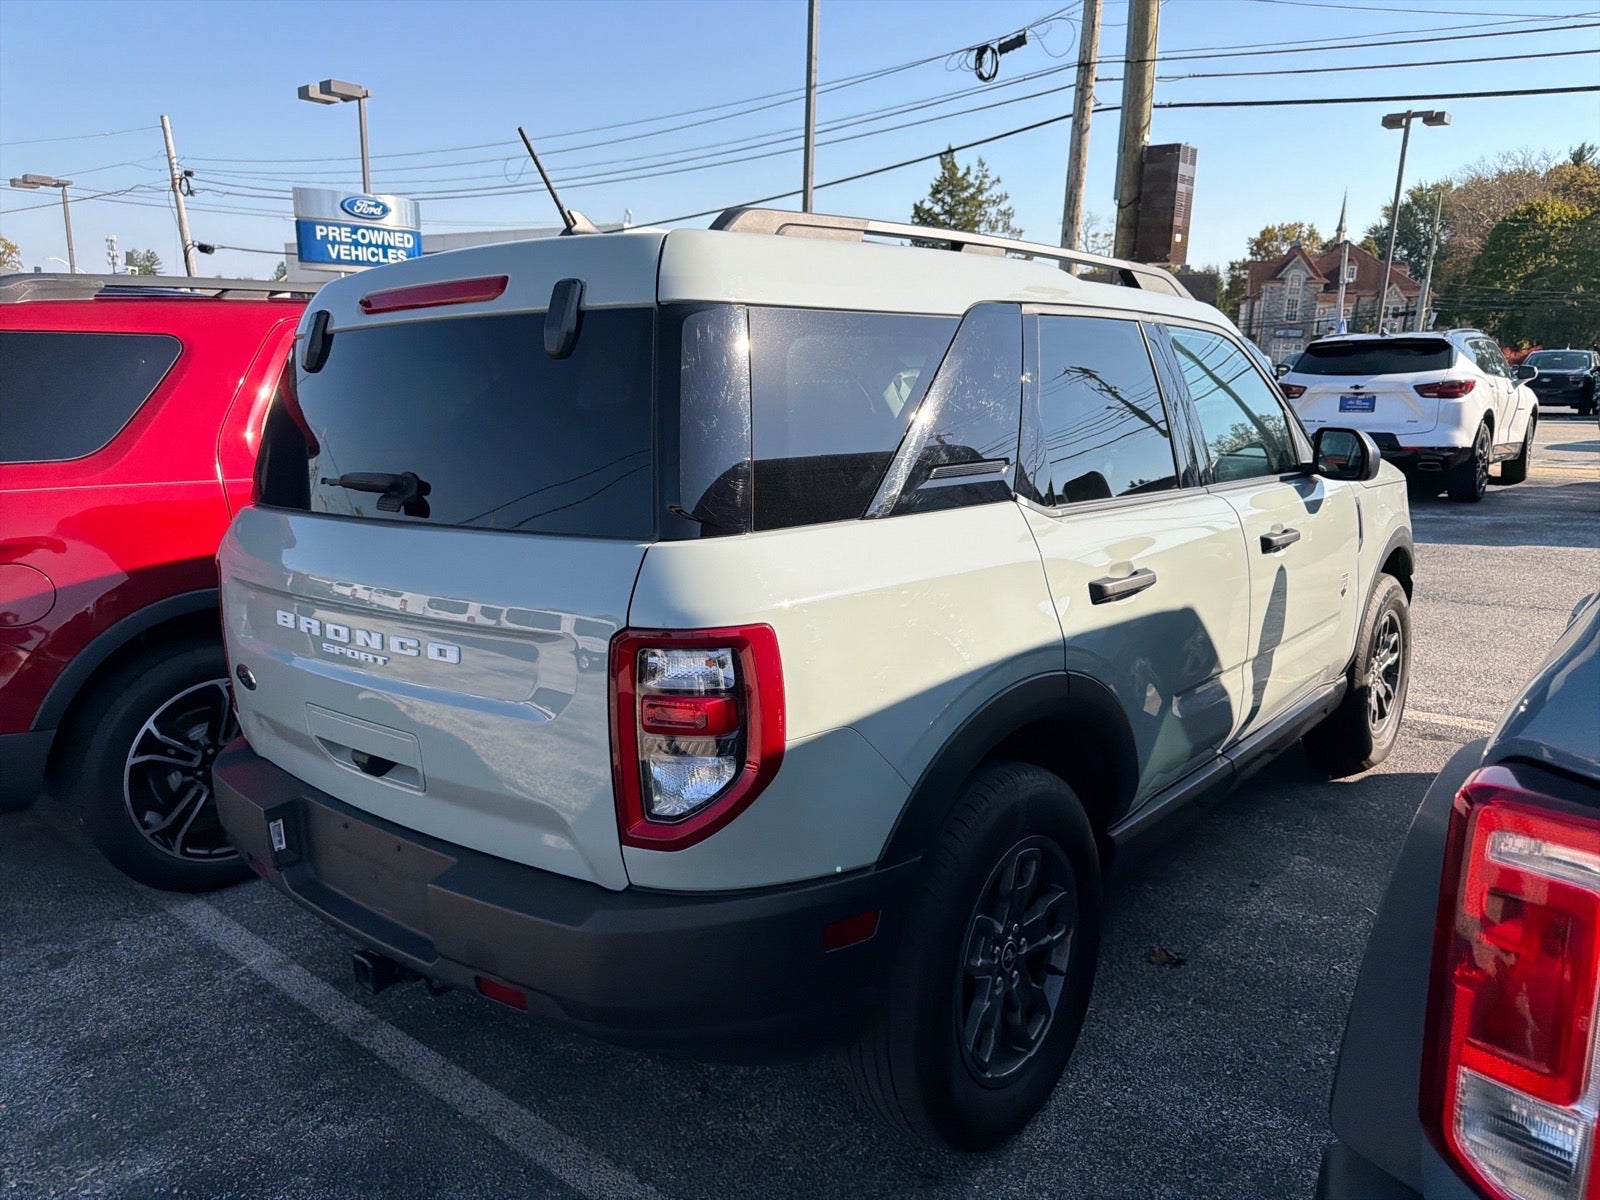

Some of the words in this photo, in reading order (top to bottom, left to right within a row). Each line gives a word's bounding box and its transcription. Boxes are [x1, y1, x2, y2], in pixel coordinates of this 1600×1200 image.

[353, 199, 383, 215] Ford
[315, 225, 414, 248] PRE-OWNED
[326, 243, 408, 263] VEHICLES
[276, 609, 462, 664] BRONCO
[322, 642, 390, 666] SPORT
